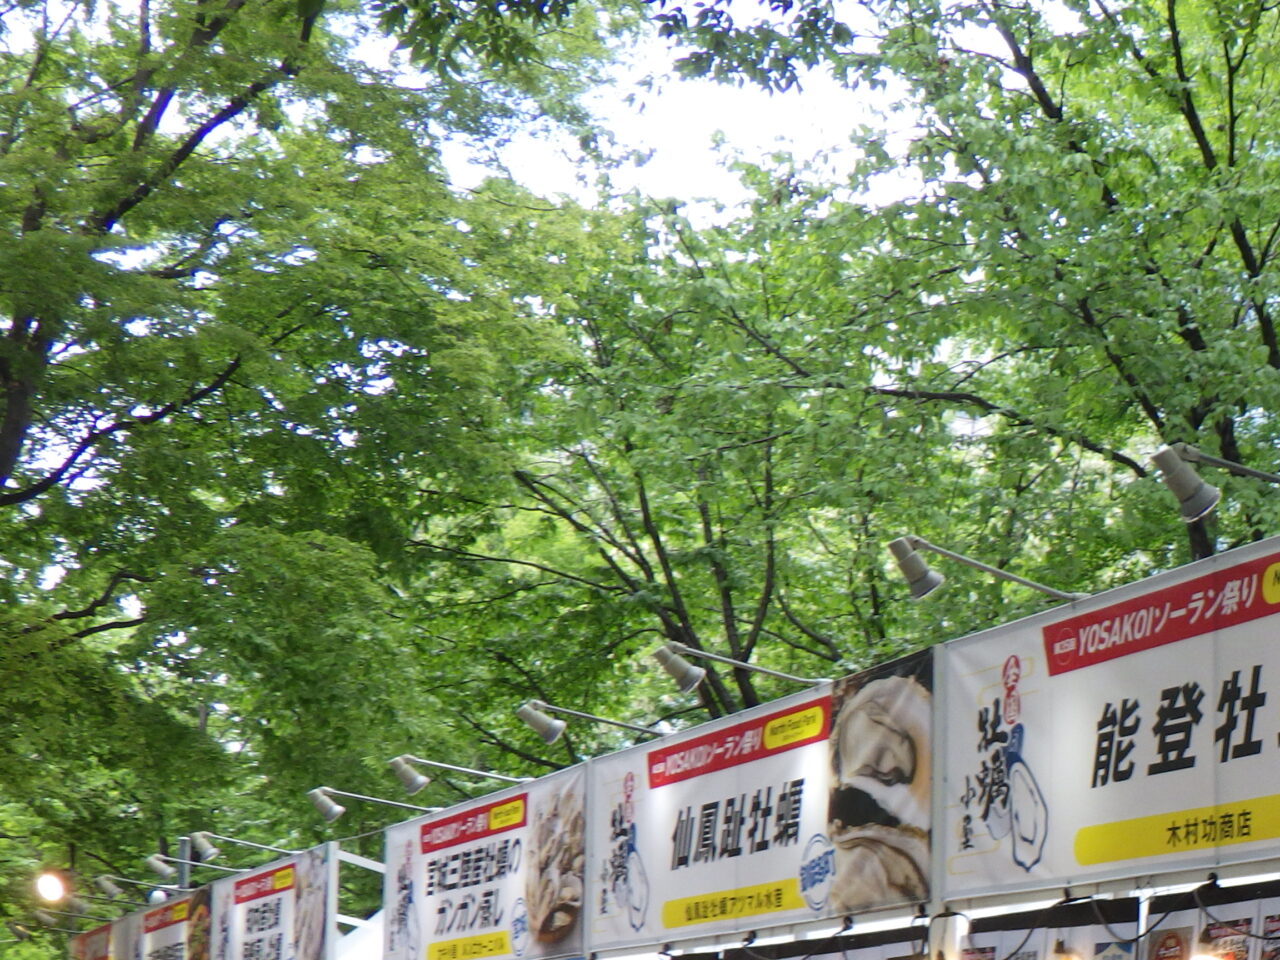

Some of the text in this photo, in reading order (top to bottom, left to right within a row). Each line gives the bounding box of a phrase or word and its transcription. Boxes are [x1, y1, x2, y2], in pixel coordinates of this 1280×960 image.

[1077, 574, 1258, 656] YOSAKOIソーラン祭り
[671, 778, 805, 871] 仙鳳趾牡蠣
[1165, 808, 1253, 848] 木村功商店
